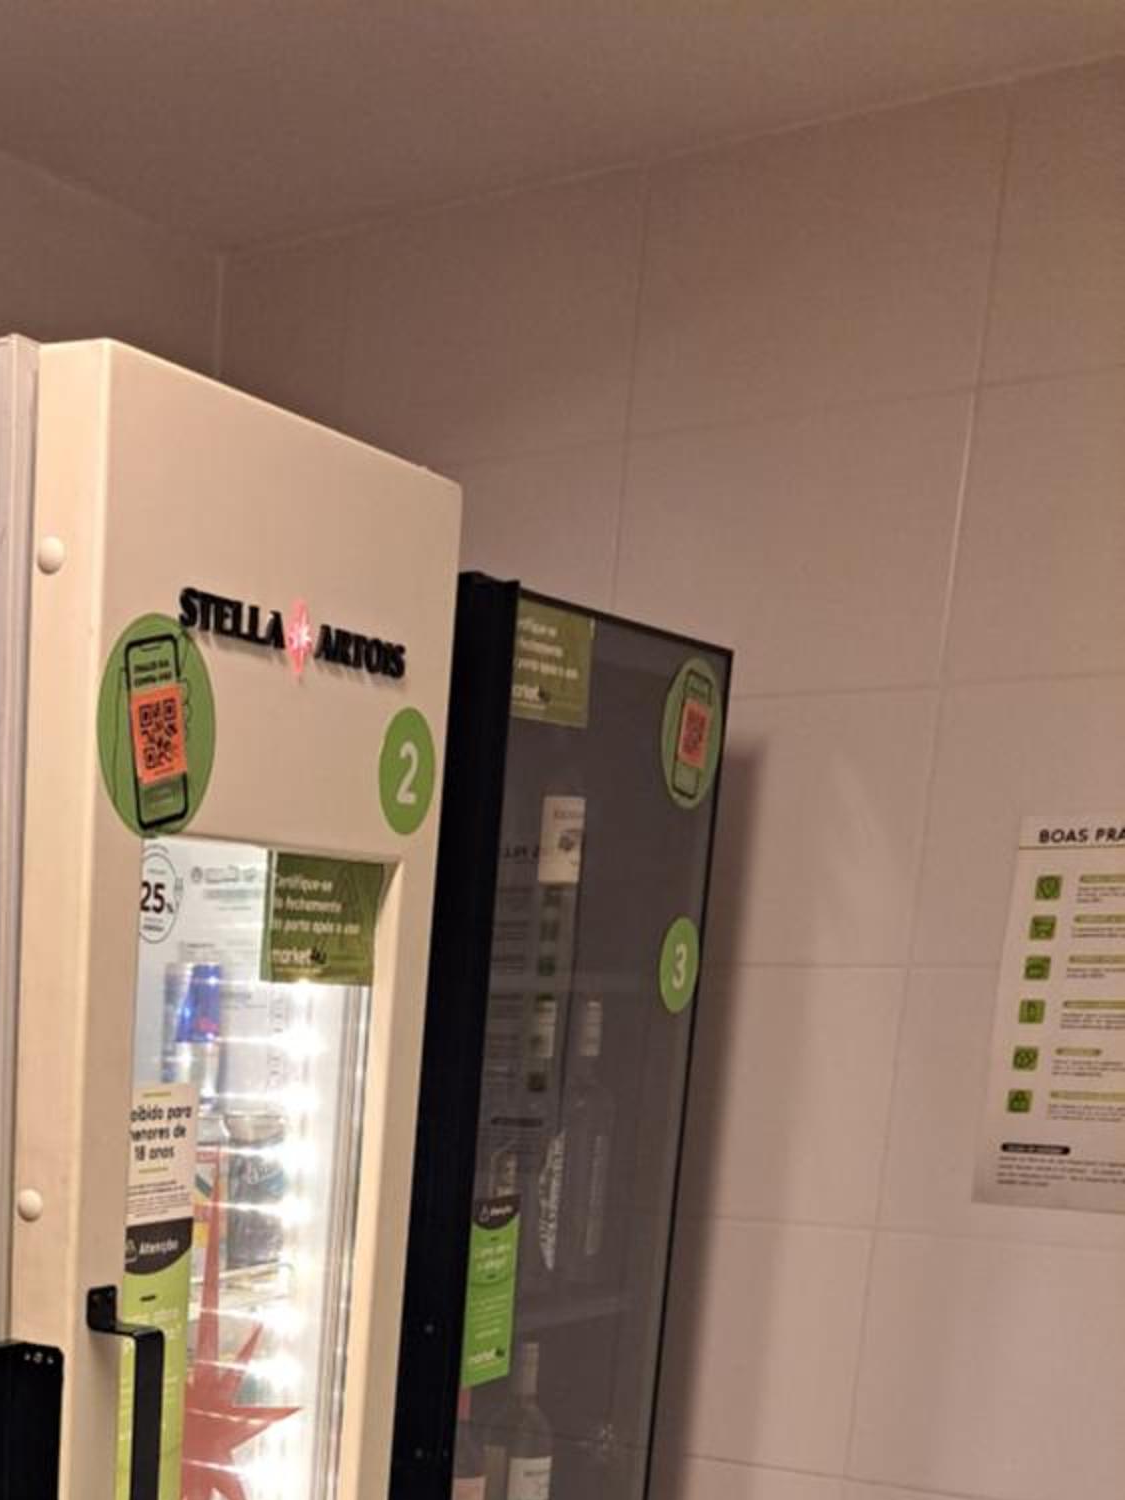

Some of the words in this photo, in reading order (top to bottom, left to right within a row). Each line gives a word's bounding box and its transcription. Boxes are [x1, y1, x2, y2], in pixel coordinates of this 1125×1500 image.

[179, 586, 286, 650] STELLA
[314, 623, 406, 679] ARTOIS
[396, 741, 419, 804] 2
[1039, 827, 1089, 843] BOAS
[672, 943, 688, 990] 3
[130, 1104, 165, 1122] oibido
[167, 1105, 193, 1121] para
[129, 1126, 171, 1142] enores
[173, 1123, 187, 1139] de
[149, 1146, 175, 1161] anos
